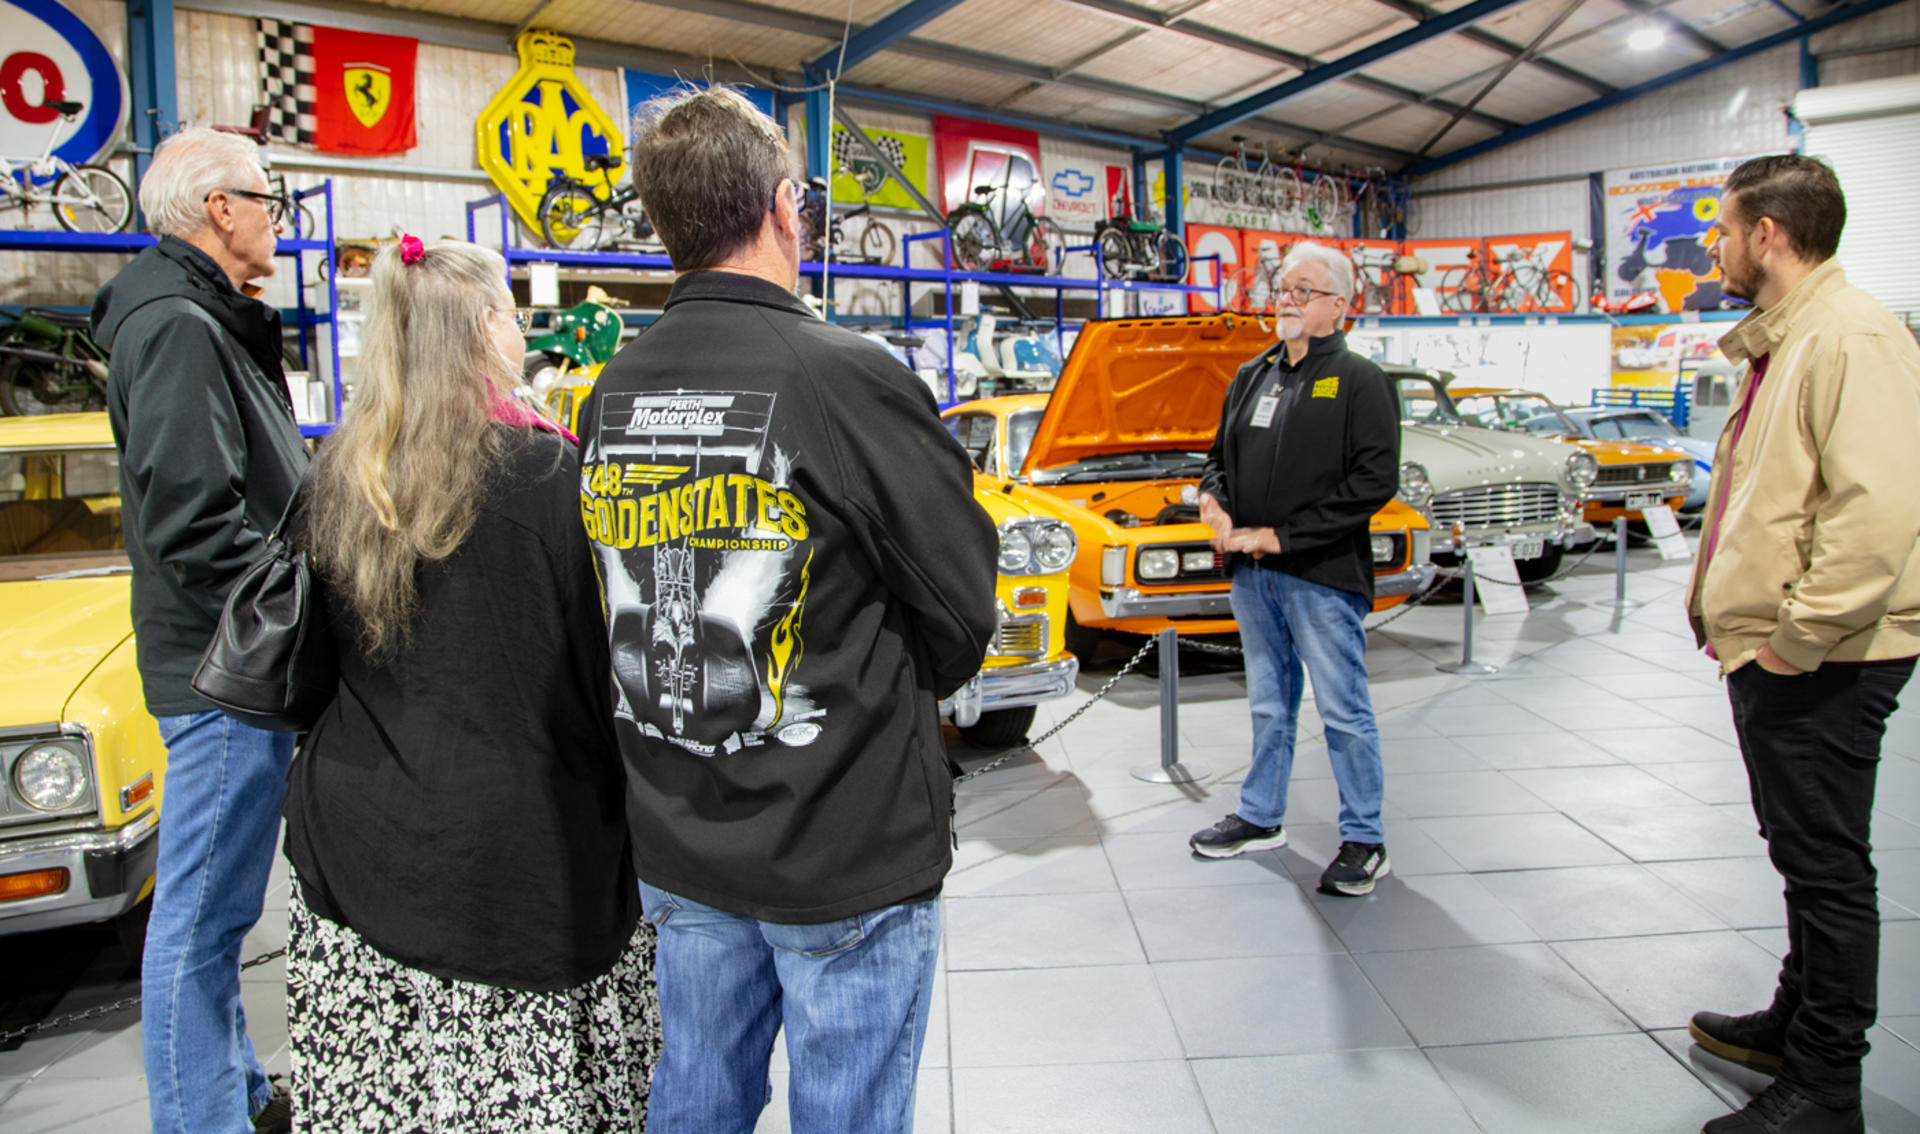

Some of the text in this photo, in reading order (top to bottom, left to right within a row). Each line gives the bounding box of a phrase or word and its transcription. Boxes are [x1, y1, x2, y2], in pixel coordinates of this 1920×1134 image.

[510, 78, 614, 195] RAC
[1194, 231, 1567, 312] CATEX
[629, 408, 726, 430] Motorplex
[669, 399, 701, 411] PERTH
[590, 462, 622, 497] 48
[622, 487, 635, 497] TH
[688, 536, 789, 551] CHAMPIONSHIP
